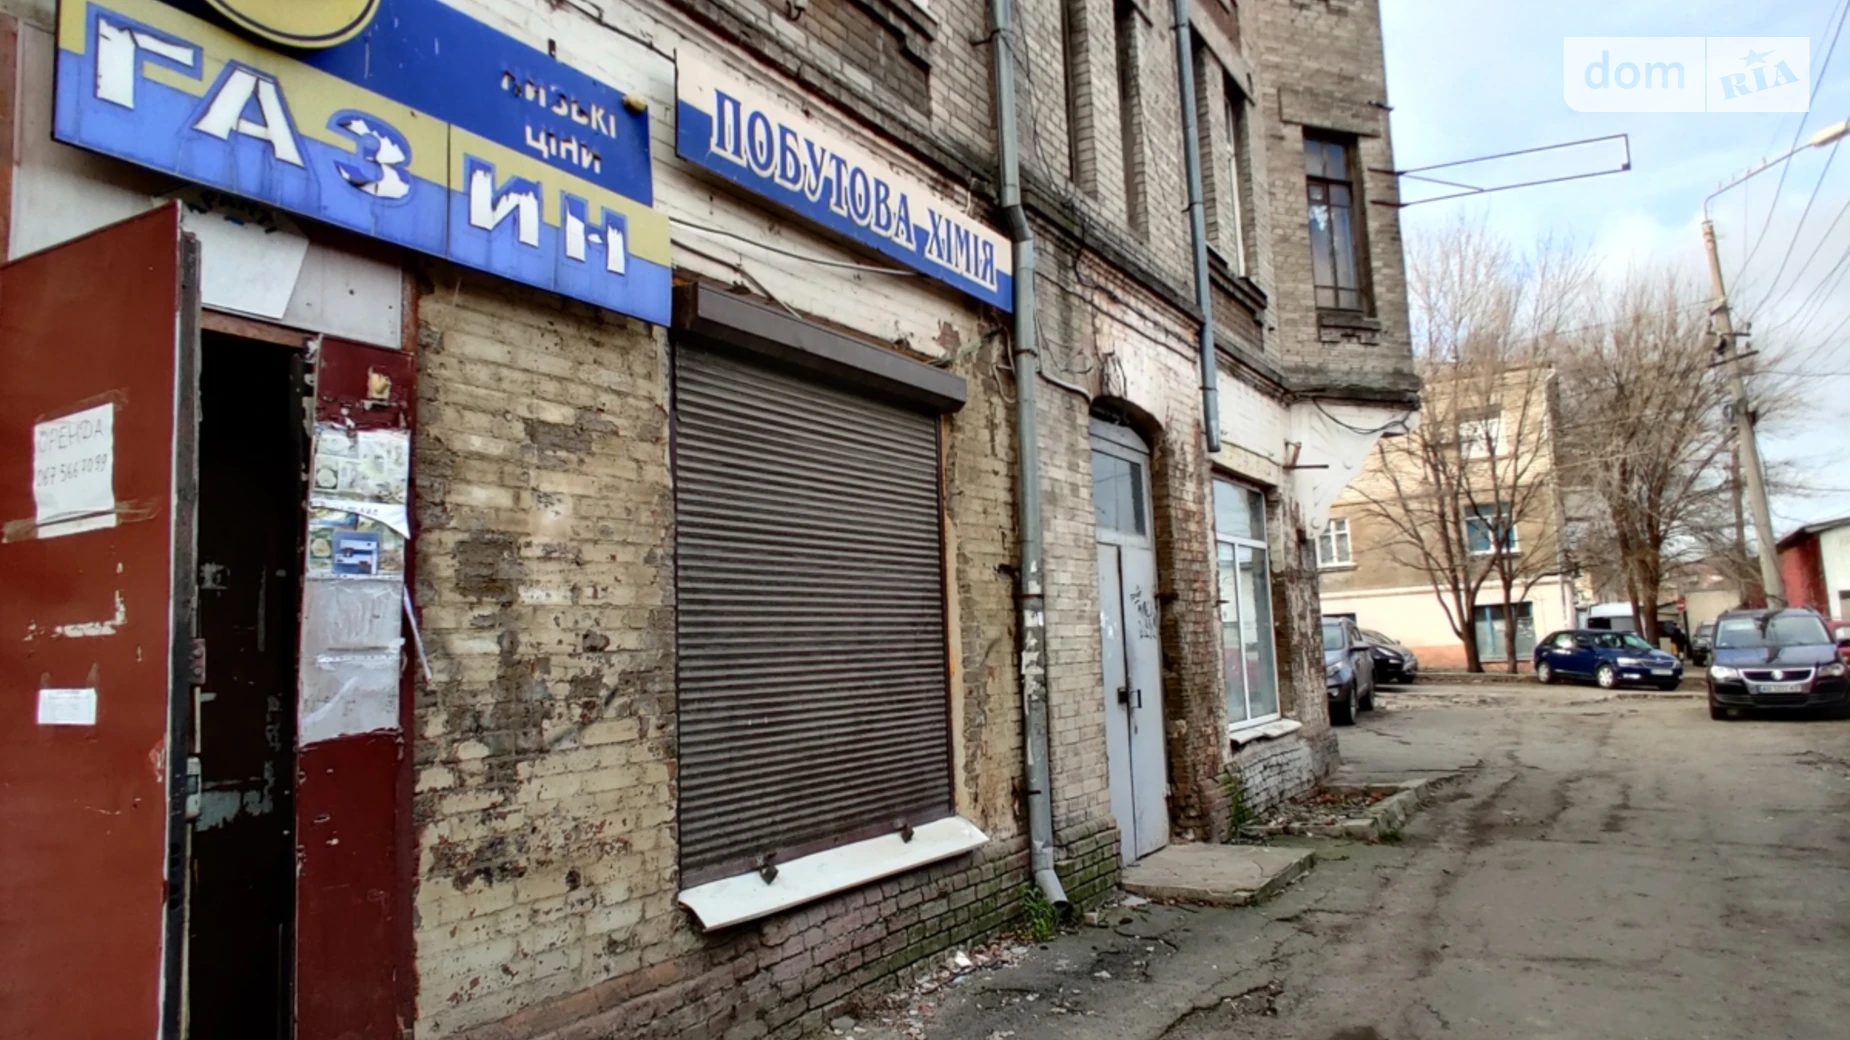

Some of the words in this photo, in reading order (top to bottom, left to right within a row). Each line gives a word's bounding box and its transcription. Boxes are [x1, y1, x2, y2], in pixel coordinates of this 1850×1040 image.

[524, 124, 601, 175] ЦІНИ
[712, 88, 916, 251] ПОБУТОВА
[925, 208, 998, 291] ХІМІЯ
